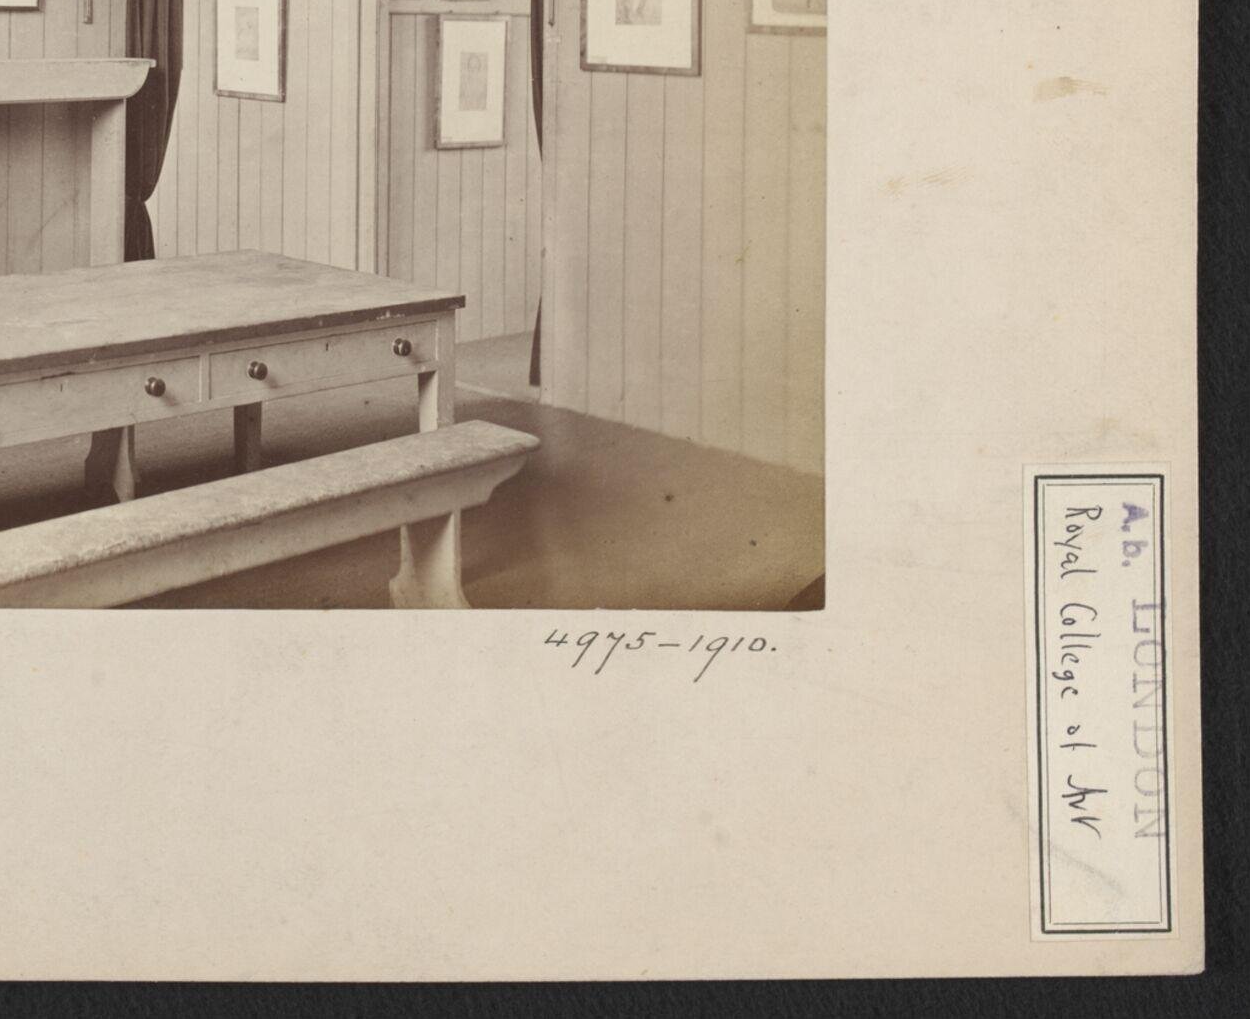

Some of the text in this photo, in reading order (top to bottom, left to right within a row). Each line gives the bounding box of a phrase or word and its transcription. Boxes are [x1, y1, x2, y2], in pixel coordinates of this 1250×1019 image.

[1054, 505, 1103, 579] Royal
[1051, 603, 1101, 699] College
[1059, 725, 1097, 751] of
[1131, 598, 1168, 840] LONDON
